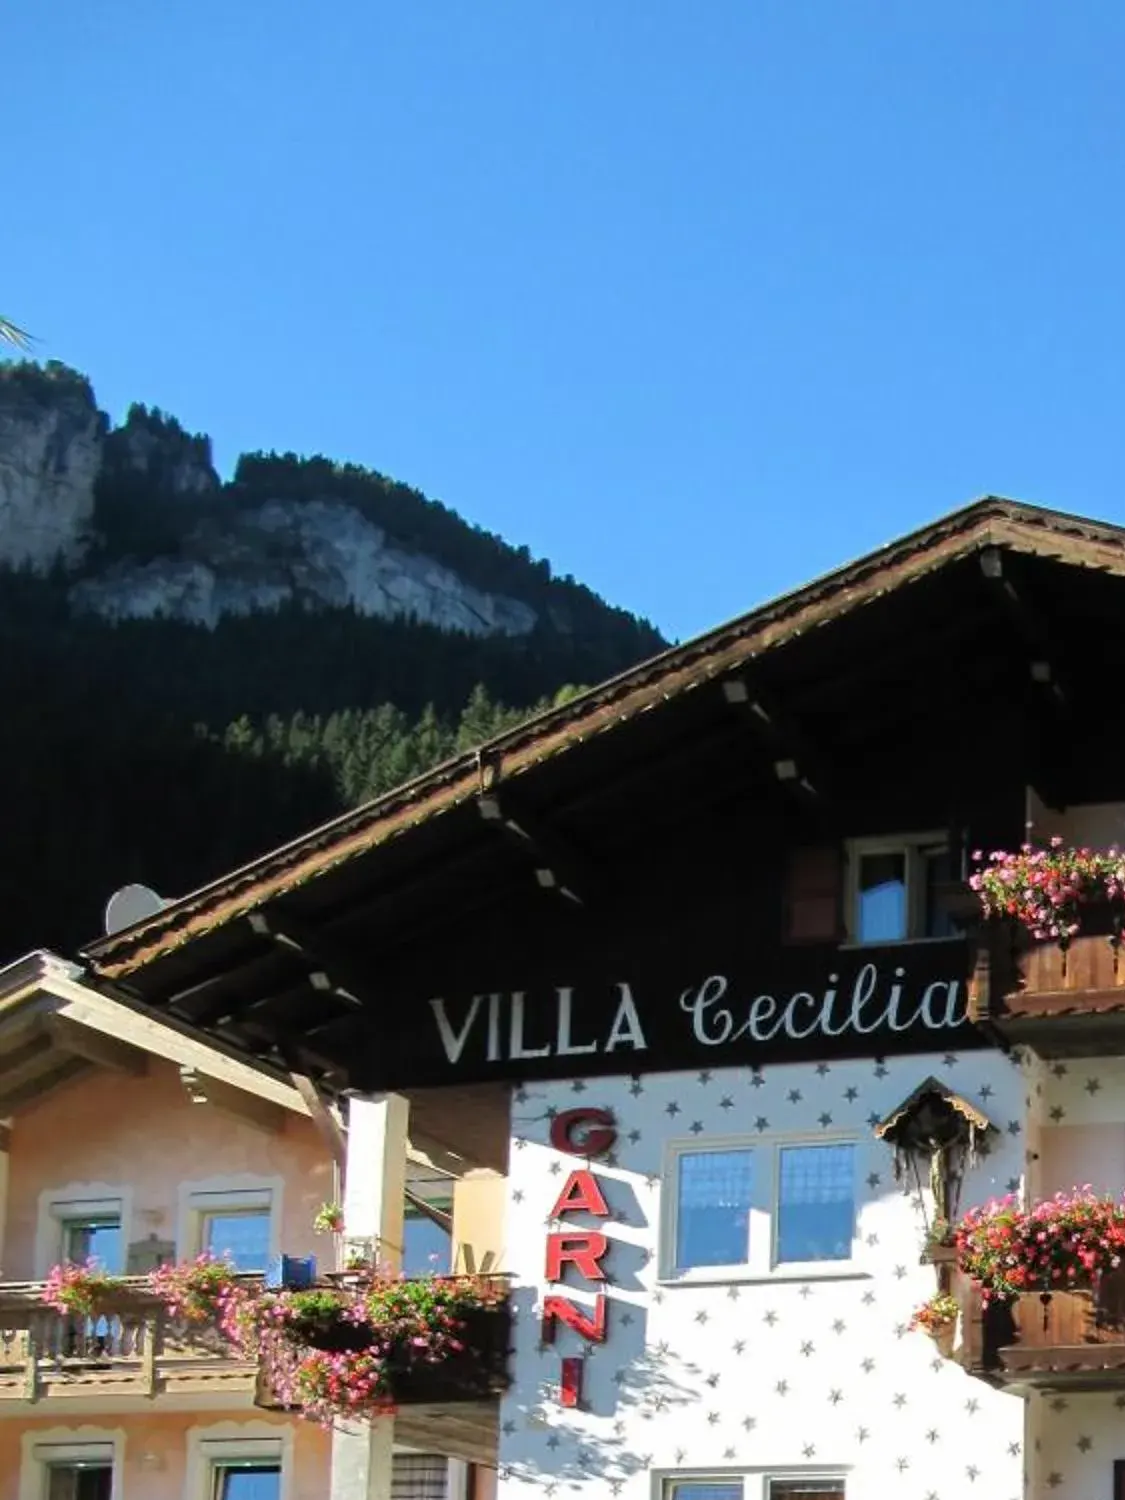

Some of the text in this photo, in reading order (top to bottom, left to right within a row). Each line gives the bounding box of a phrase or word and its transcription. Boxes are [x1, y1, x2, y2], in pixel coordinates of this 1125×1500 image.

[428, 963, 968, 1064] VILLA Cecilia
[544, 1107, 618, 1410] GARNI
